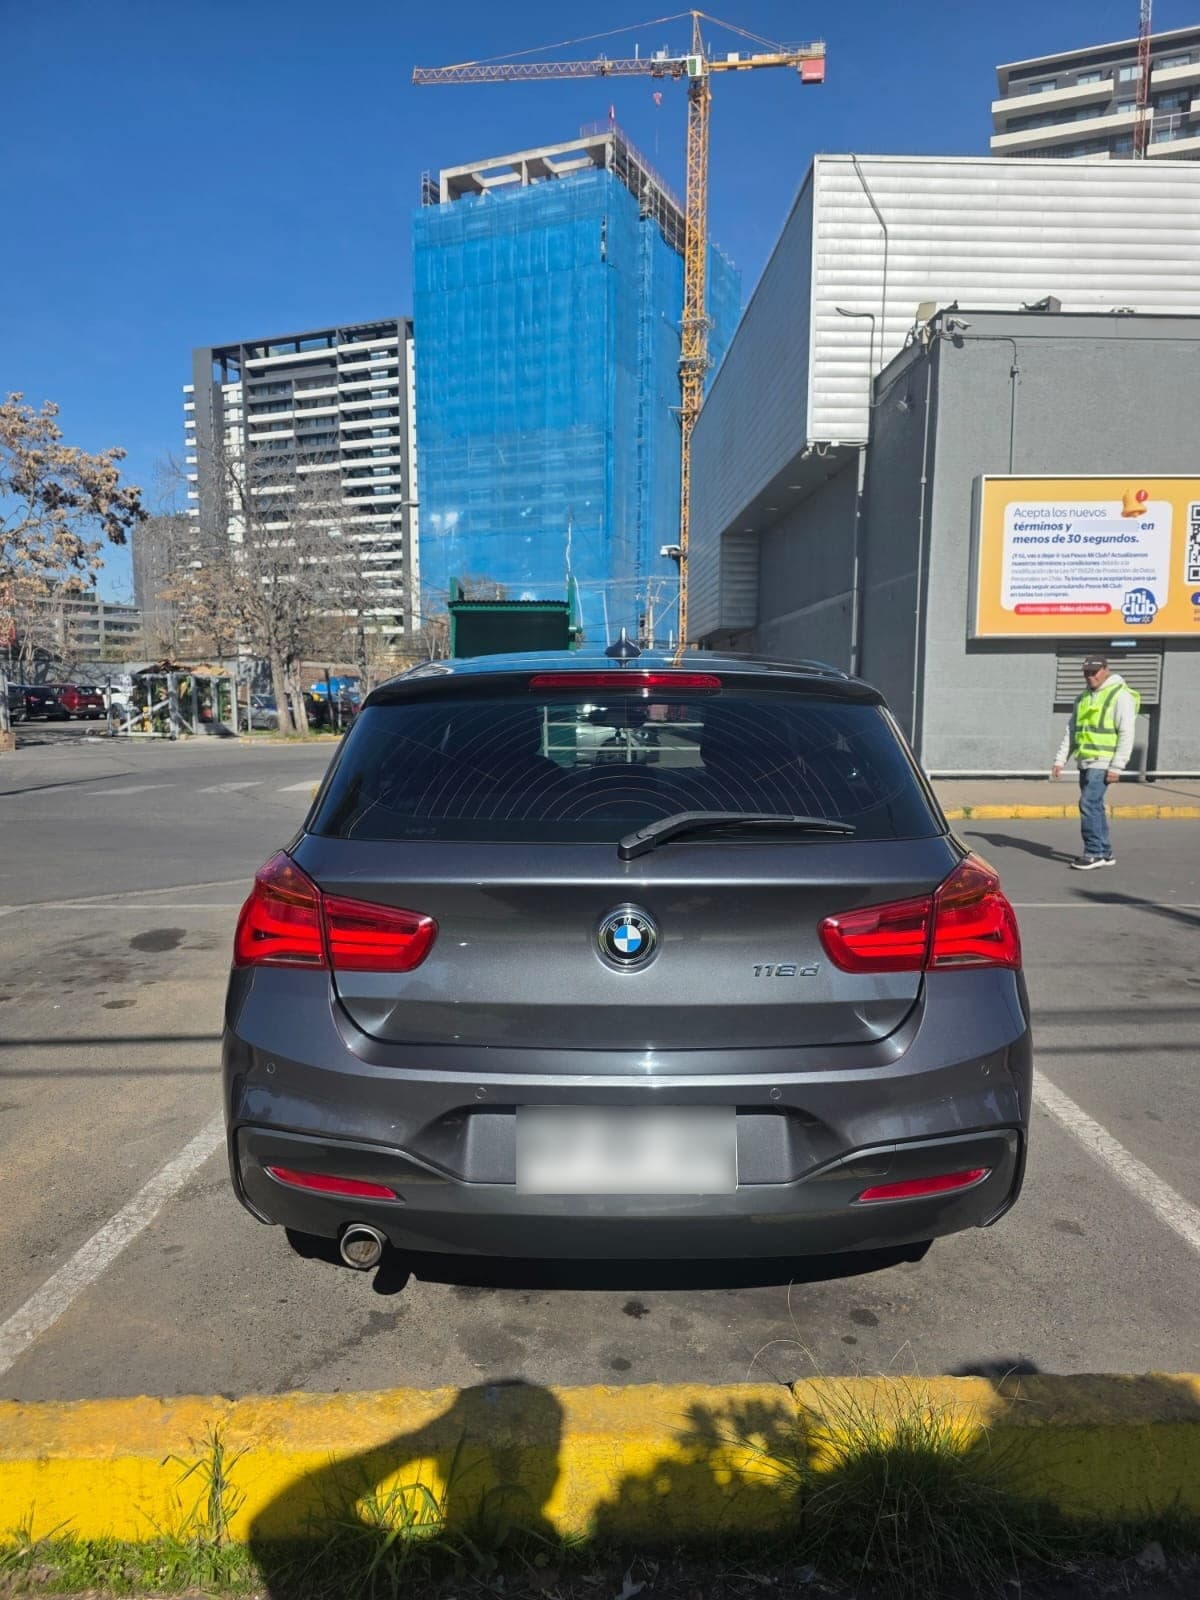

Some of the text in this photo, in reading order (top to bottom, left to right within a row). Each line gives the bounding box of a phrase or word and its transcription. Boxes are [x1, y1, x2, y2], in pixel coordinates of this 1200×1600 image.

[1014, 507, 1107, 519] Acepta los nuevos
[1014, 520, 1064, 531] términos
[1066, 523, 1073, 533] y
[1140, 522, 1155, 531] en
[1012, 533, 1139, 546] menos de 30 segundos.
[1126, 590, 1146, 604] mi
[1121, 599, 1156, 615] club
[609, 916, 648, 932] BMW
[752, 962, 820, 977] 118d
